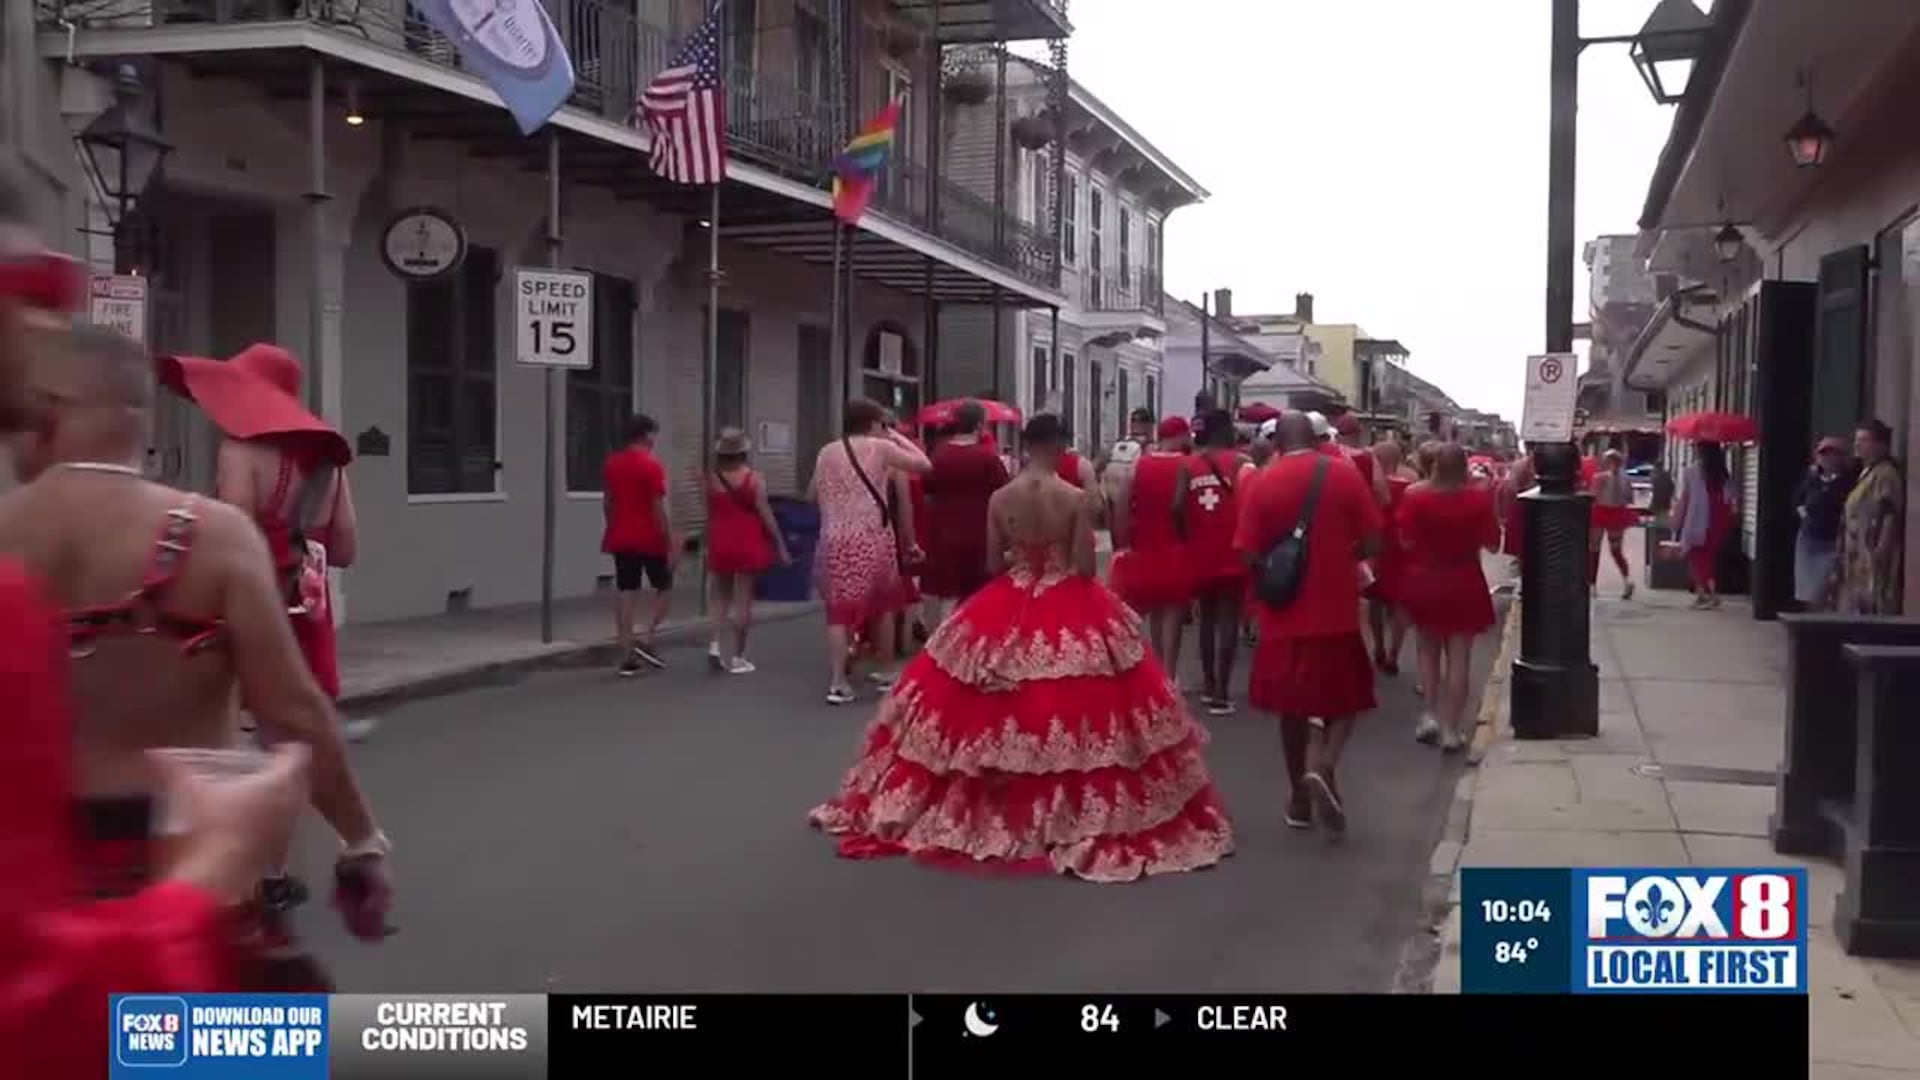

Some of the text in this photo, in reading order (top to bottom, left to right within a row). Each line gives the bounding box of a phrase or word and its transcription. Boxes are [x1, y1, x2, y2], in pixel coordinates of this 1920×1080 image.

[521, 280, 586, 298] SPEED
[528, 300, 577, 316] LIMIT
[530, 320, 577, 355] 15
